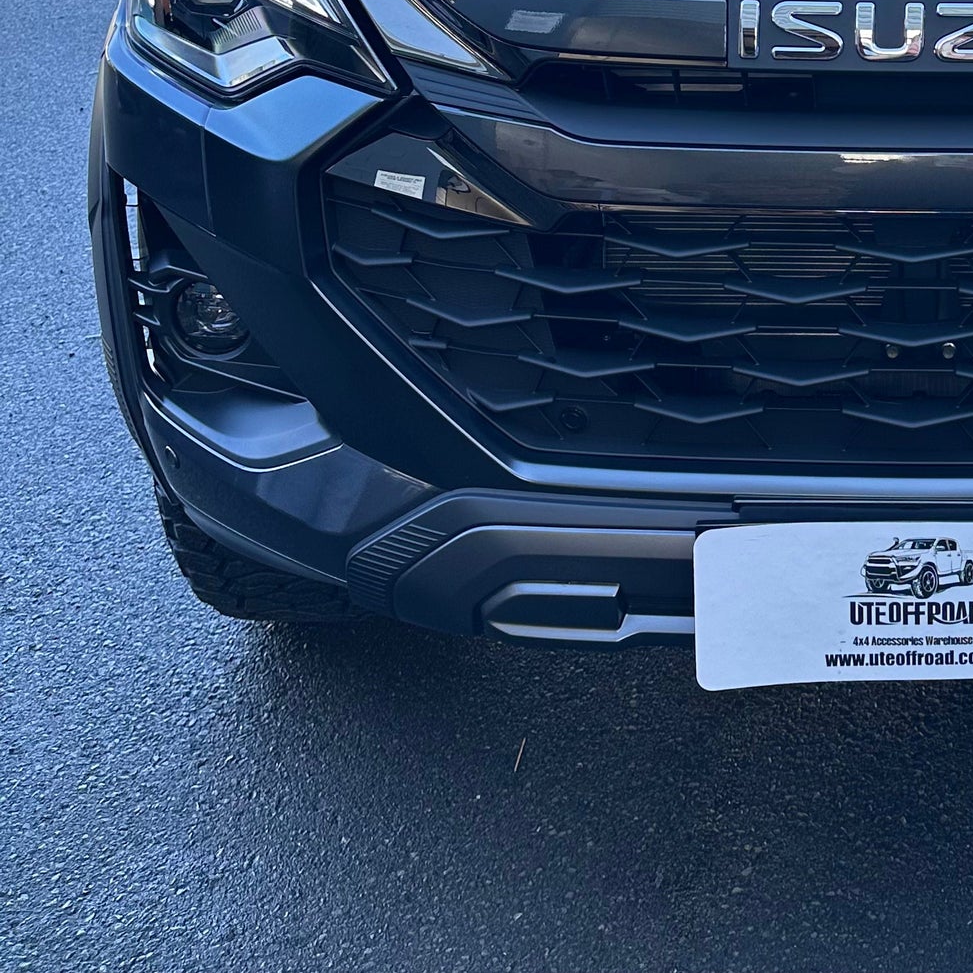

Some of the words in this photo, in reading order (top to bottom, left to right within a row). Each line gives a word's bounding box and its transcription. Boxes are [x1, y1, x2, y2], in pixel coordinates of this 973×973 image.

[852, 636, 870, 646] 4x4
[871, 636, 924, 646] Accessories
[925, 635, 973, 646] Warehouse
